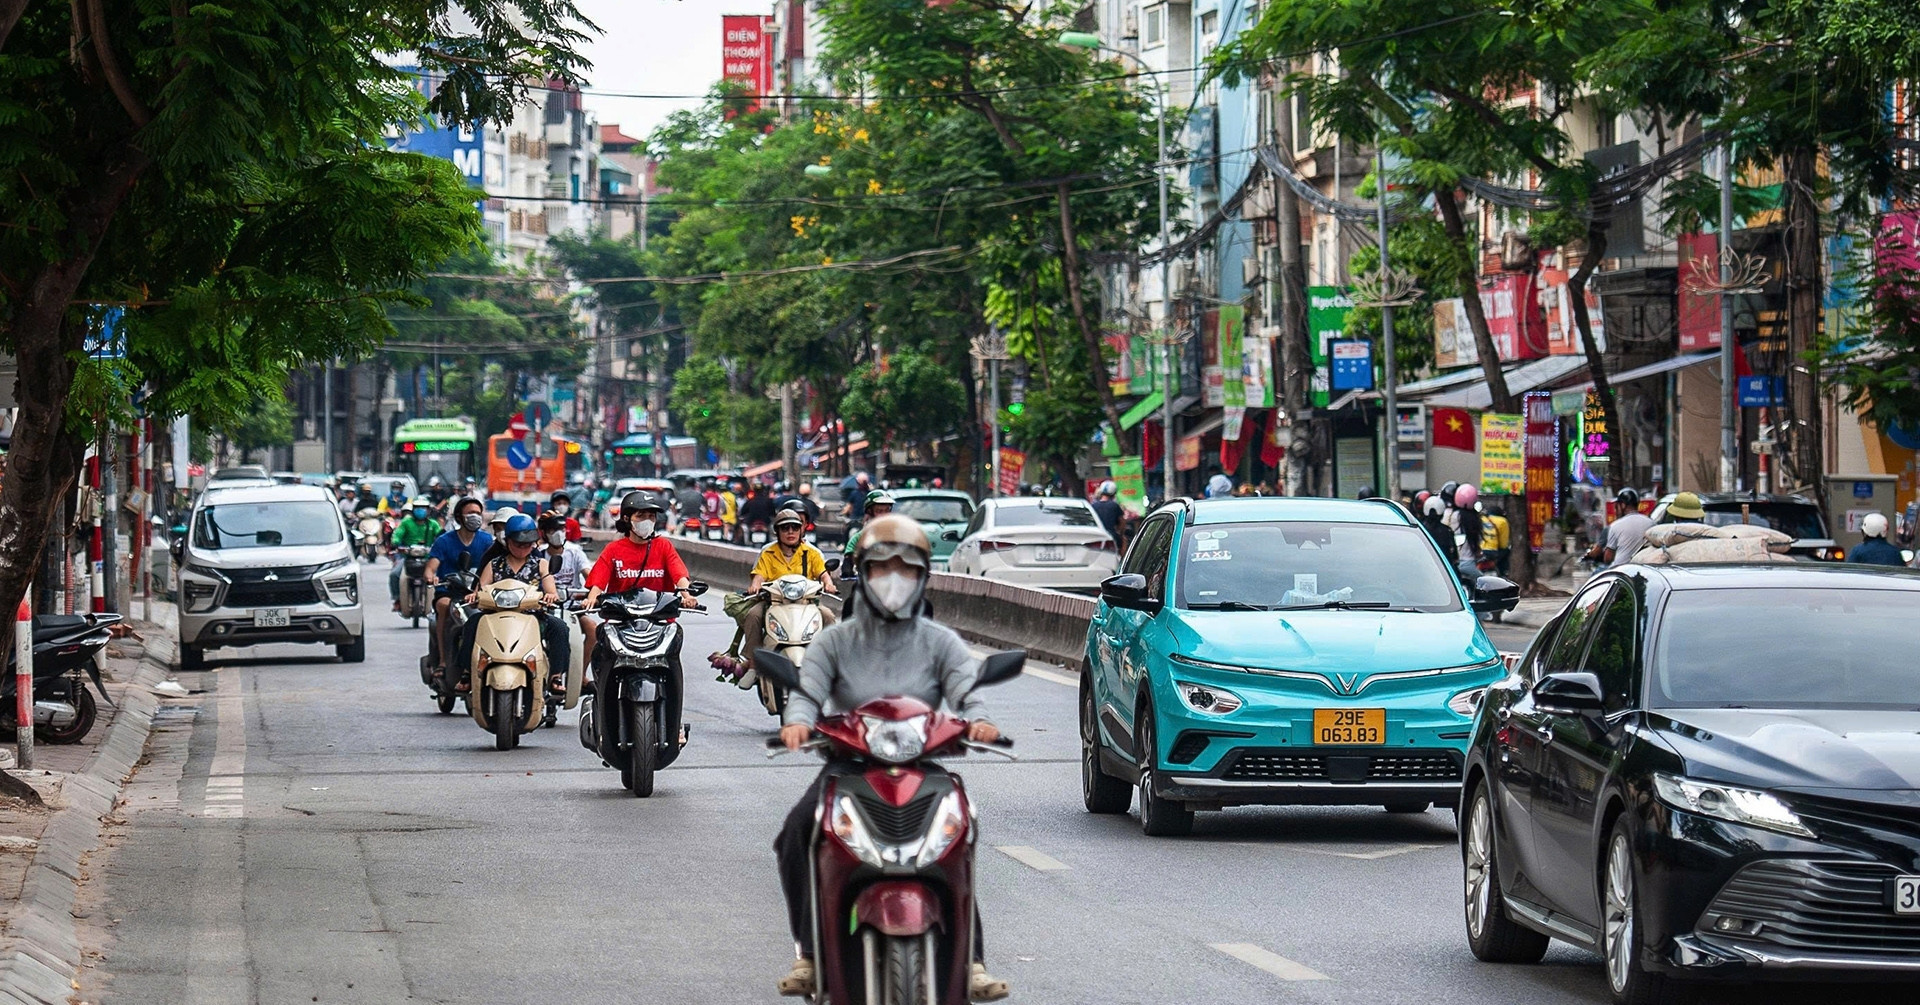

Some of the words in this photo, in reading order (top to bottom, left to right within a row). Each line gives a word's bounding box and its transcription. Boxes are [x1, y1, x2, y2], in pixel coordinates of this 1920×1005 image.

[1194, 550, 1229, 559] TAXI
[1334, 711, 1365, 726] 29E
[1321, 728, 1378, 743] 063.83
